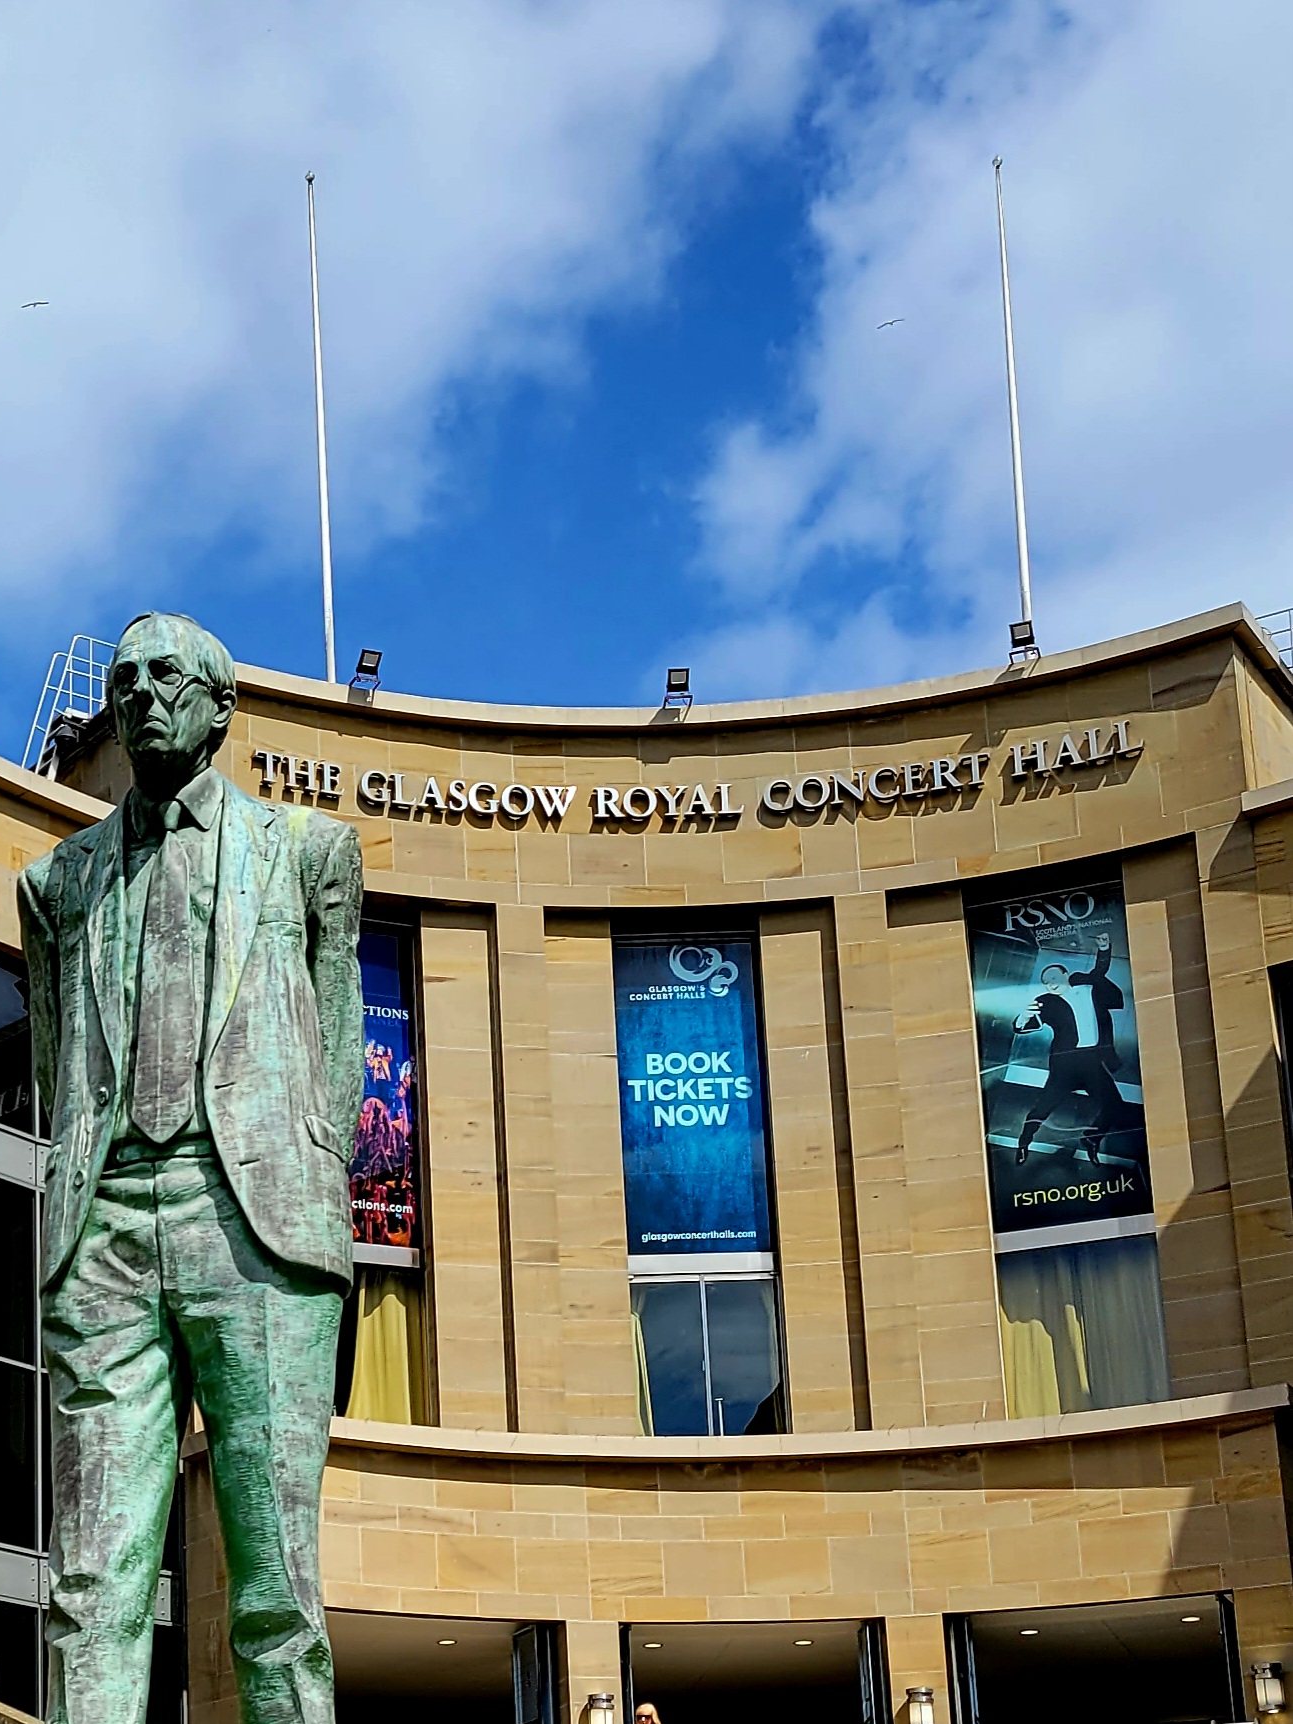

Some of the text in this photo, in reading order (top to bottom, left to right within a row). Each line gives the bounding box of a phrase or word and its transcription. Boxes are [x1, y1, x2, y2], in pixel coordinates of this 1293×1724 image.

[254, 720, 1144, 820] THE GLASGOW ROYAL CONCERT HALL
[1003, 891, 1095, 932] RSNO
[1079, 917, 1114, 930] NATIONAL
[629, 993, 673, 1001] CONCERT
[648, 985, 707, 993] GLASGOW'S
[646, 1051, 732, 1075] BOOK
[627, 1076, 753, 1102] TICKETS
[653, 1104, 730, 1127] NOW
[1013, 1174, 1135, 1207] rsno.org.uk
[641, 1229, 757, 1243] glasgowconcerthalls.com
